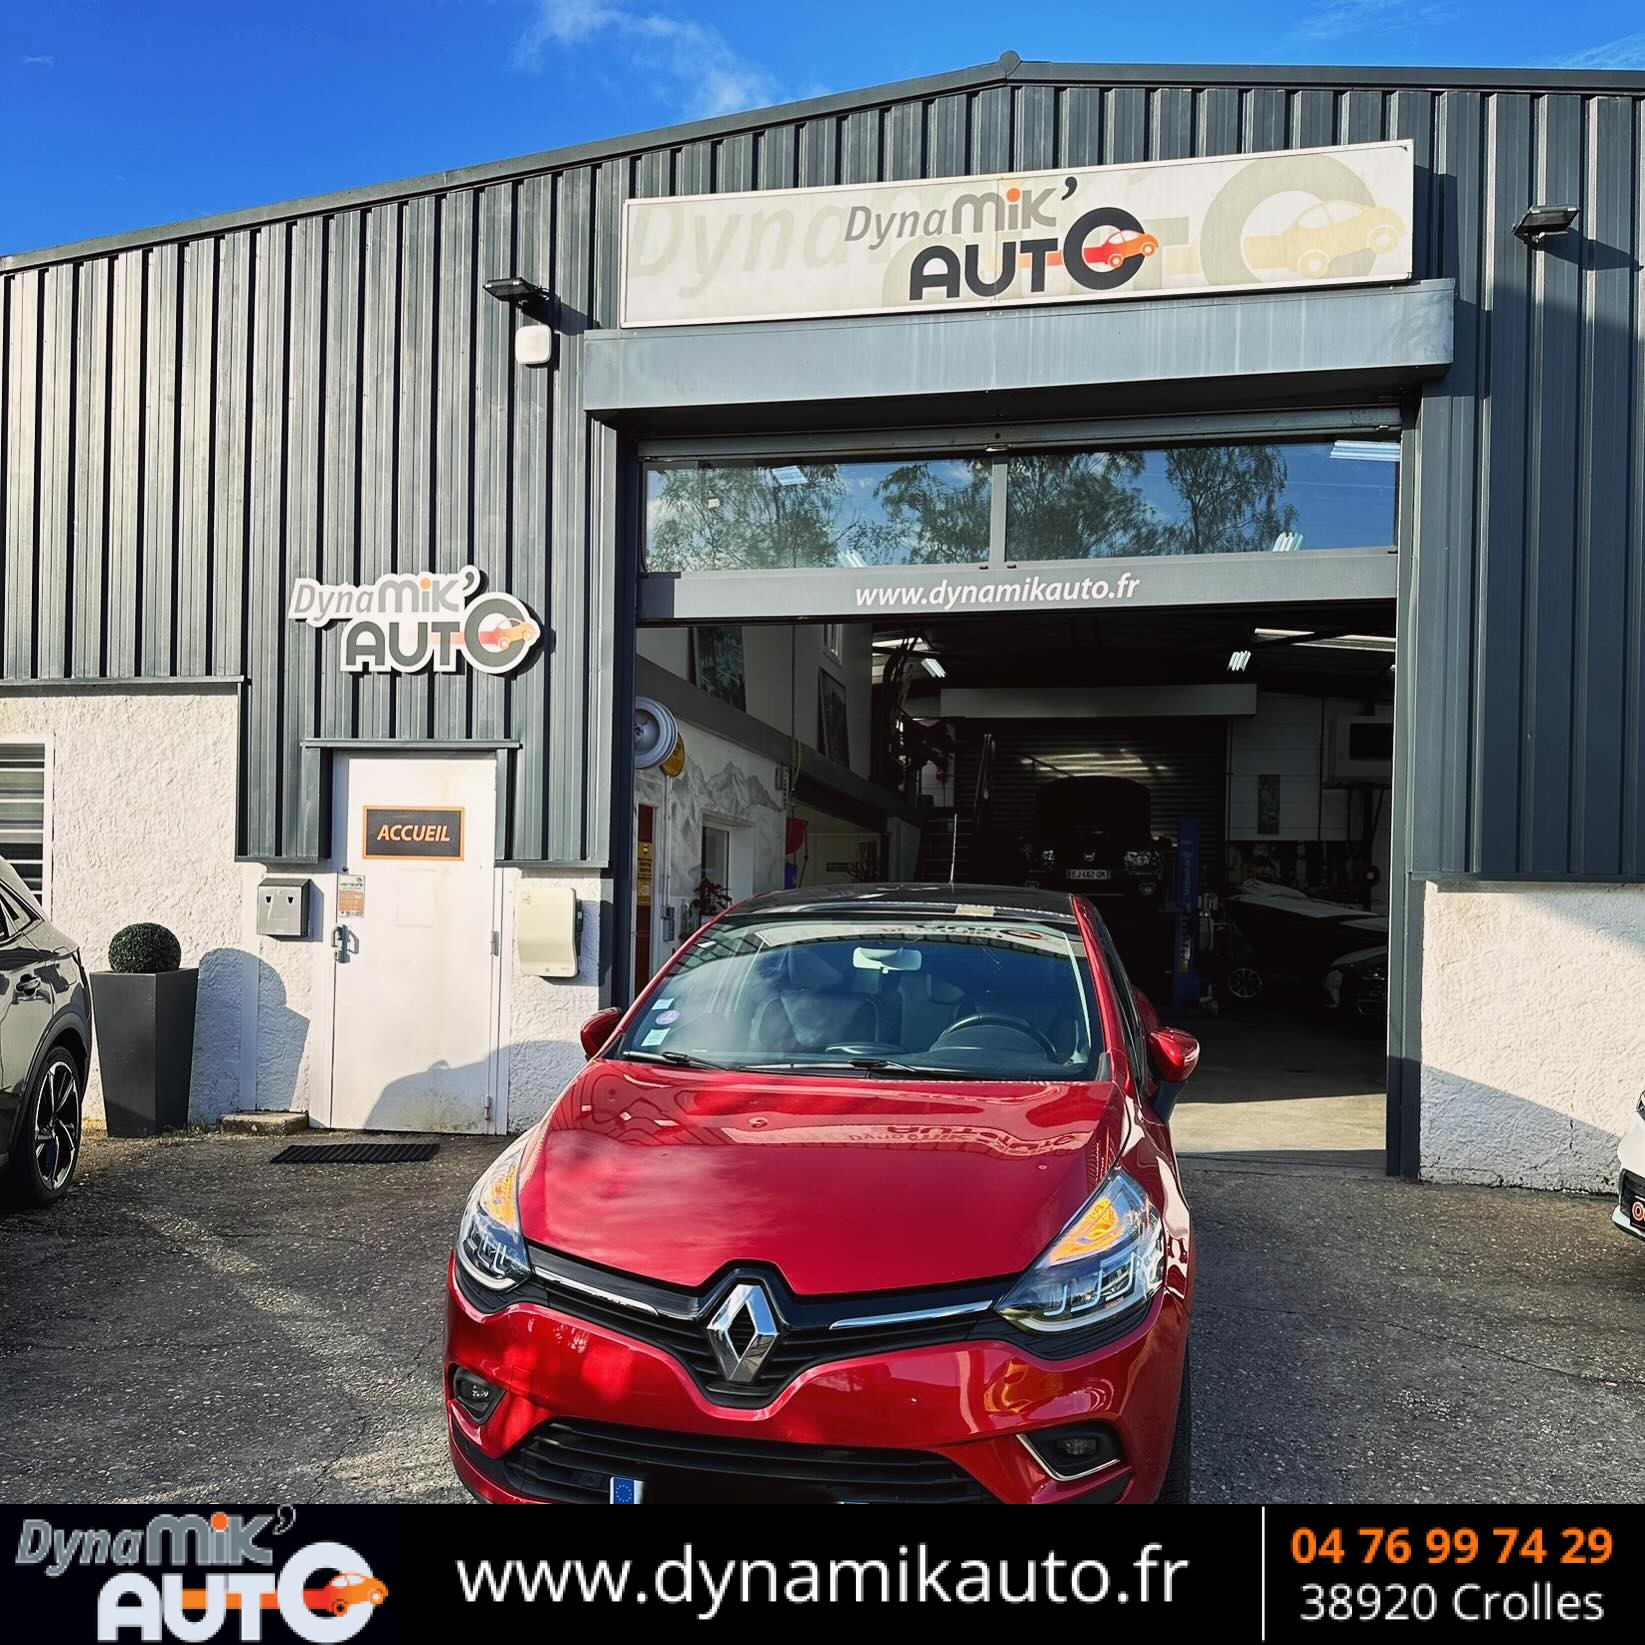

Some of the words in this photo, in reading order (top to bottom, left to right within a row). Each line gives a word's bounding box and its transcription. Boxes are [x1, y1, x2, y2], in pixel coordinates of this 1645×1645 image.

[909, 207, 1146, 301] AUTO
[855, 573, 1140, 610] www.dynamikauto.fr
[345, 598, 527, 668] AUTO
[376, 824, 451, 843] ACCUEIL
